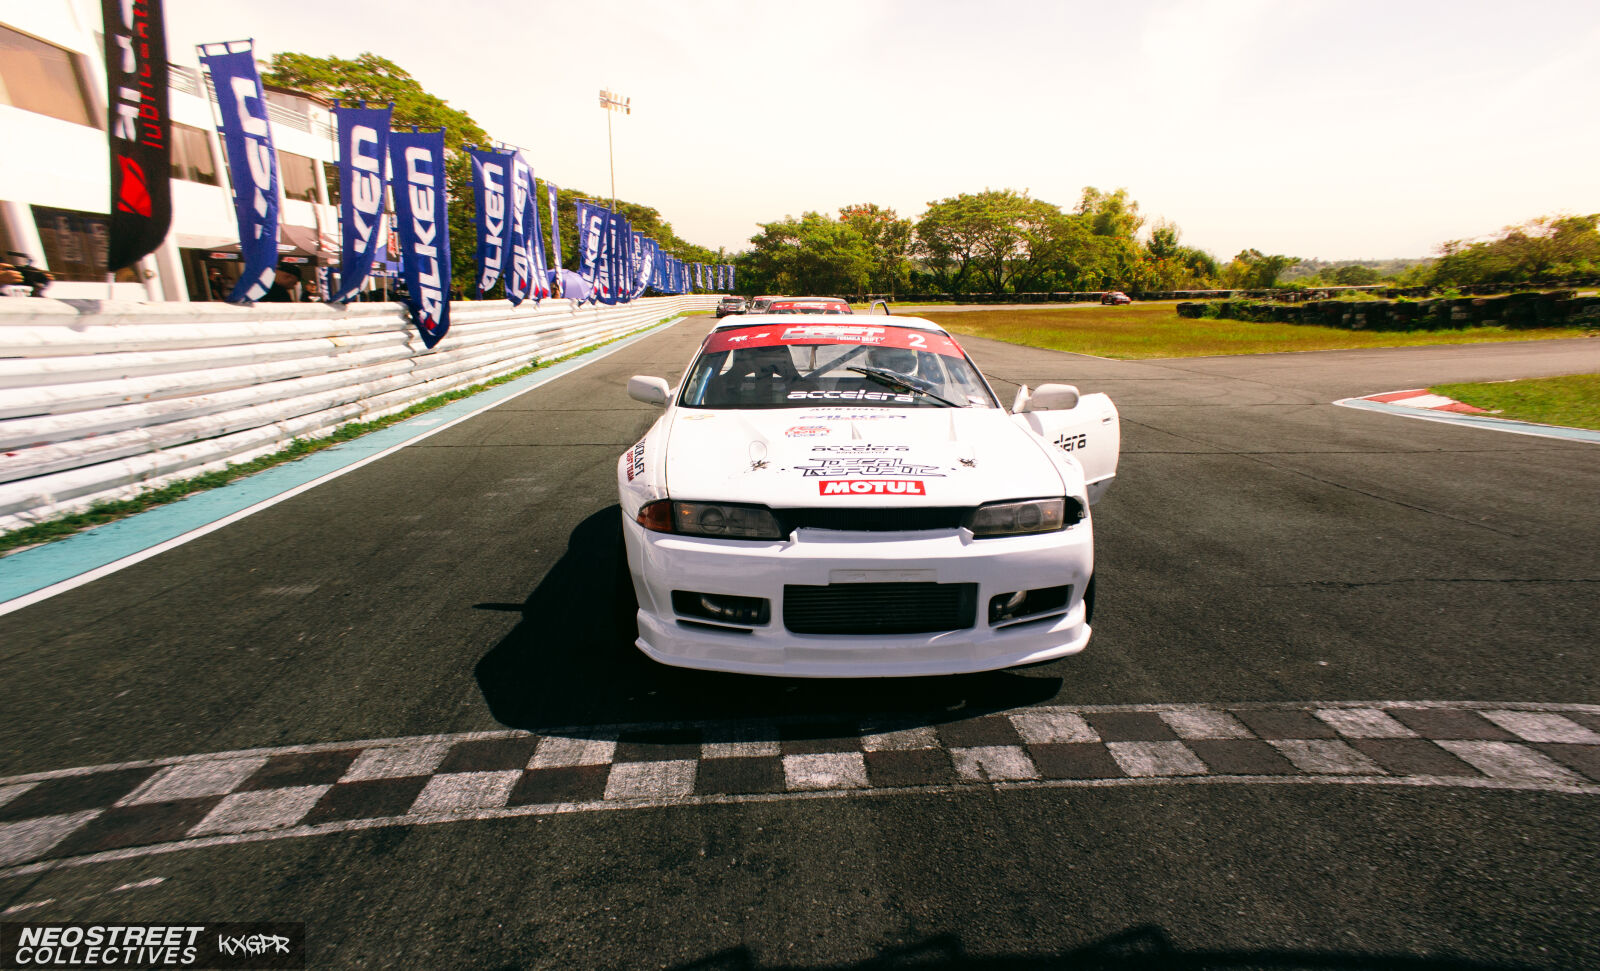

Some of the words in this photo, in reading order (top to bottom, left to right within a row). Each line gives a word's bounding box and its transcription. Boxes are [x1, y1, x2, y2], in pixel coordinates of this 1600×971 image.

[482, 161, 505, 292] ALKEN
[405, 146, 442, 327] ALKEN
[908, 333, 927, 349] 2
[787, 388, 914, 402] accelera
[812, 443, 910, 452] accelera
[823, 481, 921, 495] MOTUL
